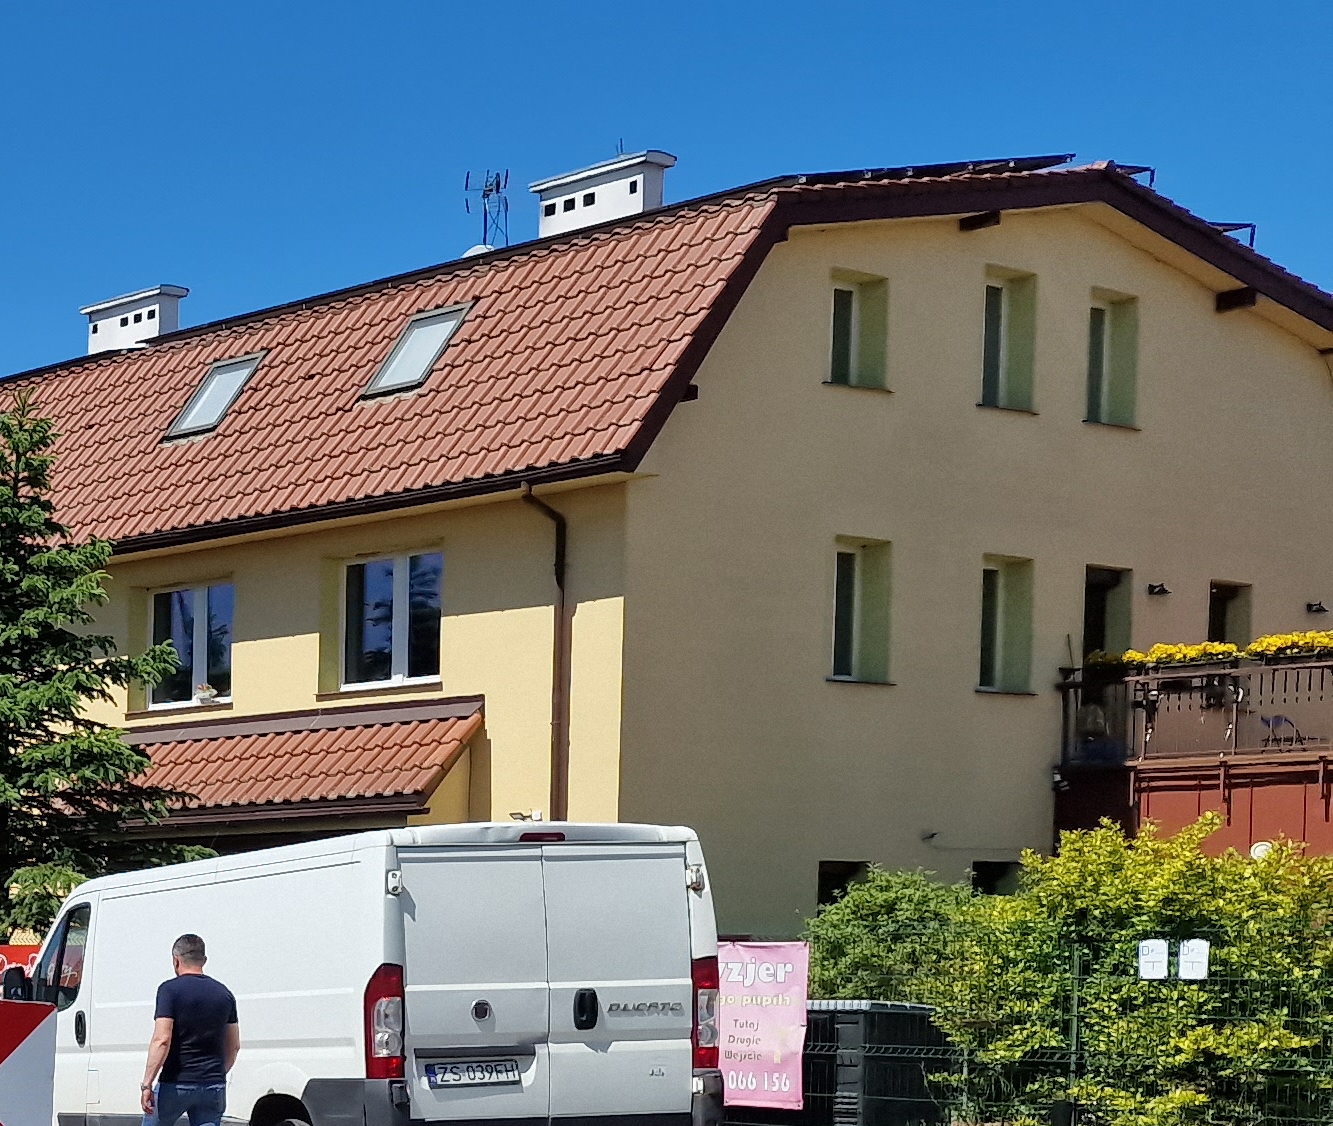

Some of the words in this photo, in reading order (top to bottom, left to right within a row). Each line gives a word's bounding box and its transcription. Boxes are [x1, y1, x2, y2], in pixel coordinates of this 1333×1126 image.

[608, 1002, 683, 1013] DUCATO
[733, 1019, 759, 1032] Tutaj
[728, 1035, 761, 1047] Drugie
[438, 1066, 462, 1082] ZS
[466, 1063, 516, 1080] 039FH
[728, 1071, 757, 1091] 066
[764, 1072, 790, 1093] 156
